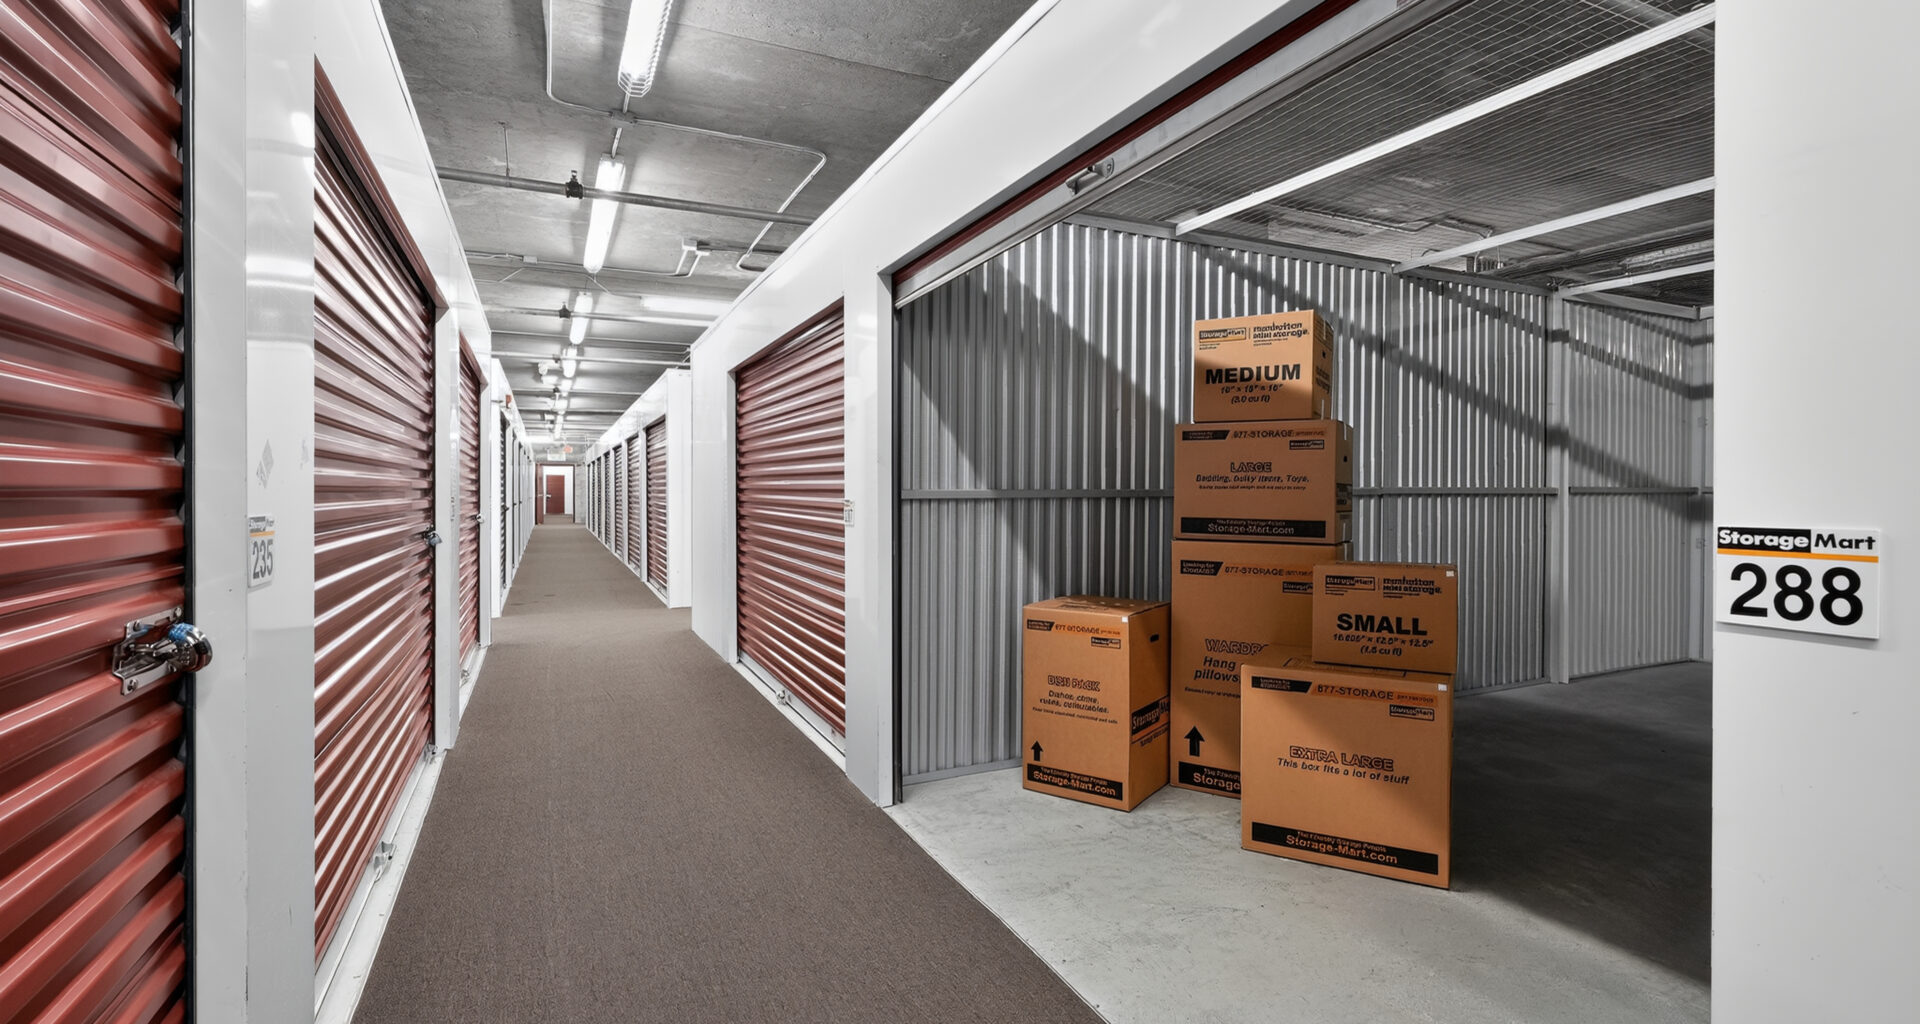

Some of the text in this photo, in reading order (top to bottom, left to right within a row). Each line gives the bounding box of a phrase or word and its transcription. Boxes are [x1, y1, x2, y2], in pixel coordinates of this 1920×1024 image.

[1206, 364, 1301, 385] MEDIUM
[1230, 462, 1272, 473] LARGE
[1719, 529, 1876, 550] Storage Mart
[252, 538, 274, 580] 235
[1730, 562, 1864, 627] 288
[1336, 613, 1428, 636] SMALL
[1205, 638, 1264, 656] WARDR
[1203, 656, 1237, 671] Hang
[1317, 684, 1394, 700] 877-STORAGE
[1289, 745, 1394, 772] EXTRA LARGE
[1278, 757, 1410, 785] This box fits a lot of stuff
[1033, 770, 1117, 797] Storage-Mart.com
[1286, 834, 1398, 864] Storage-Mart.com
